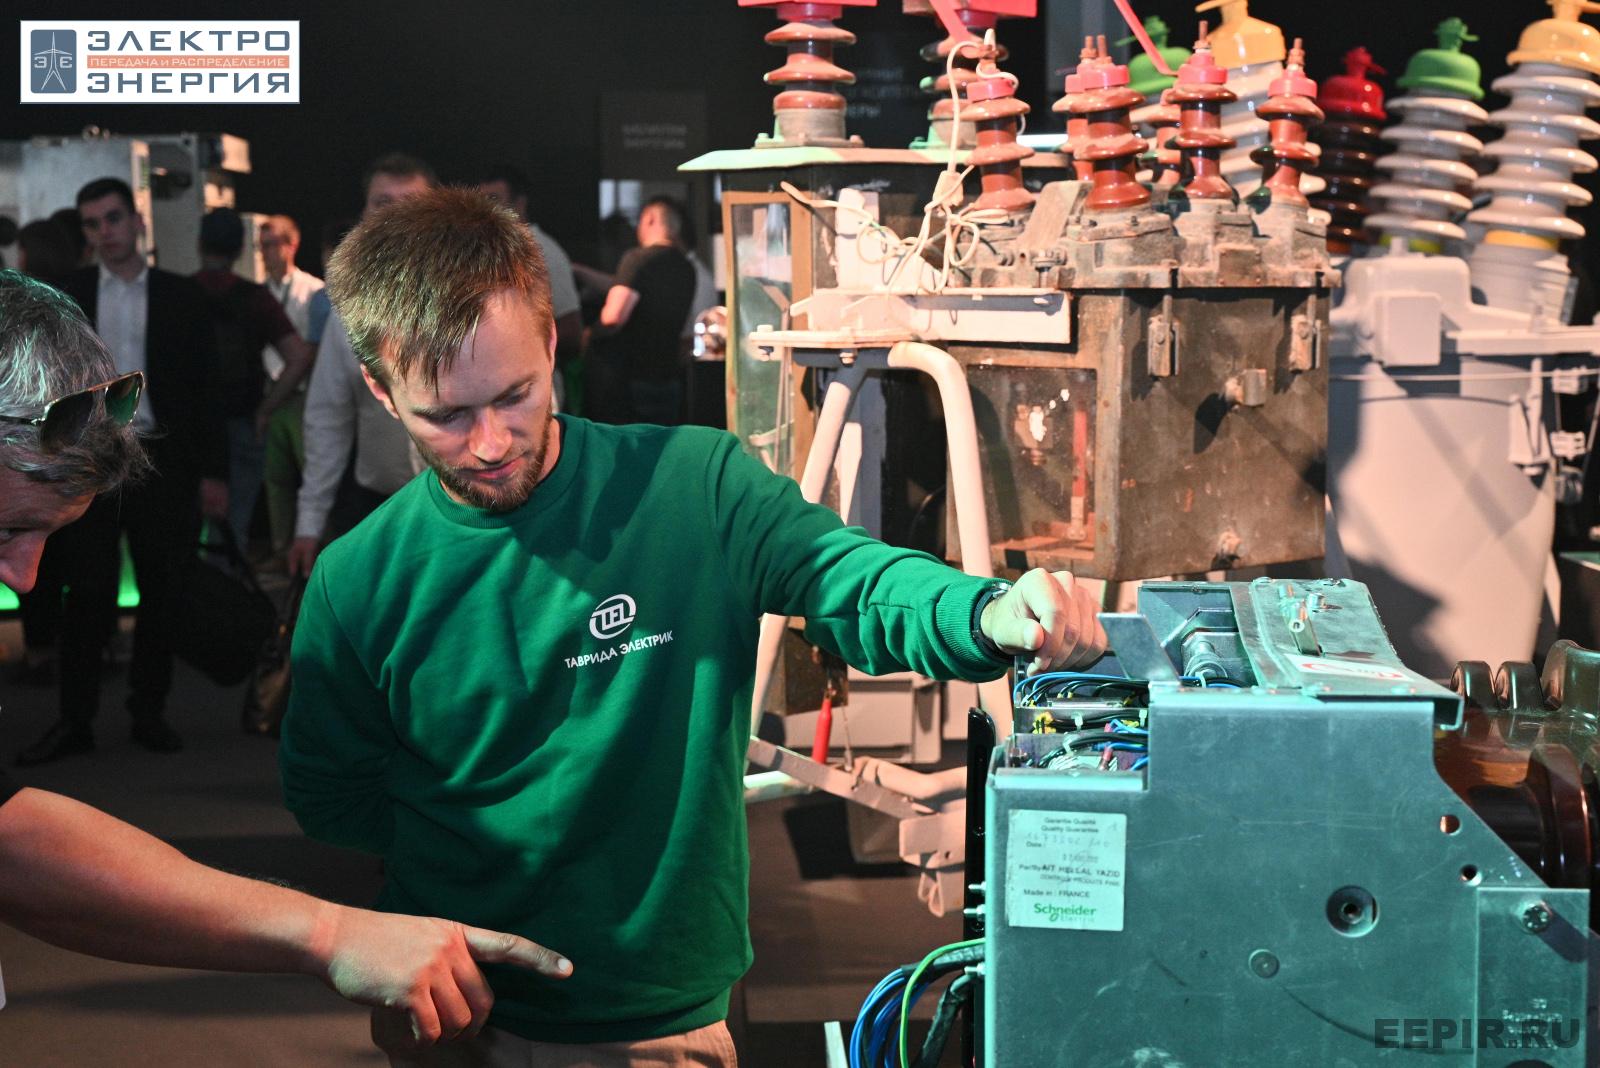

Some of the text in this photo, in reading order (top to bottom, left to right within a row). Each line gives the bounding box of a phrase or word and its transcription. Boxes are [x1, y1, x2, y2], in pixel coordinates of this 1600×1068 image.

[564, 630, 674, 669] ТАВРИДА ЭЛЕКТРИК
[1023, 889, 1044, 897] Made
[1034, 903, 1096, 917] Schneider
